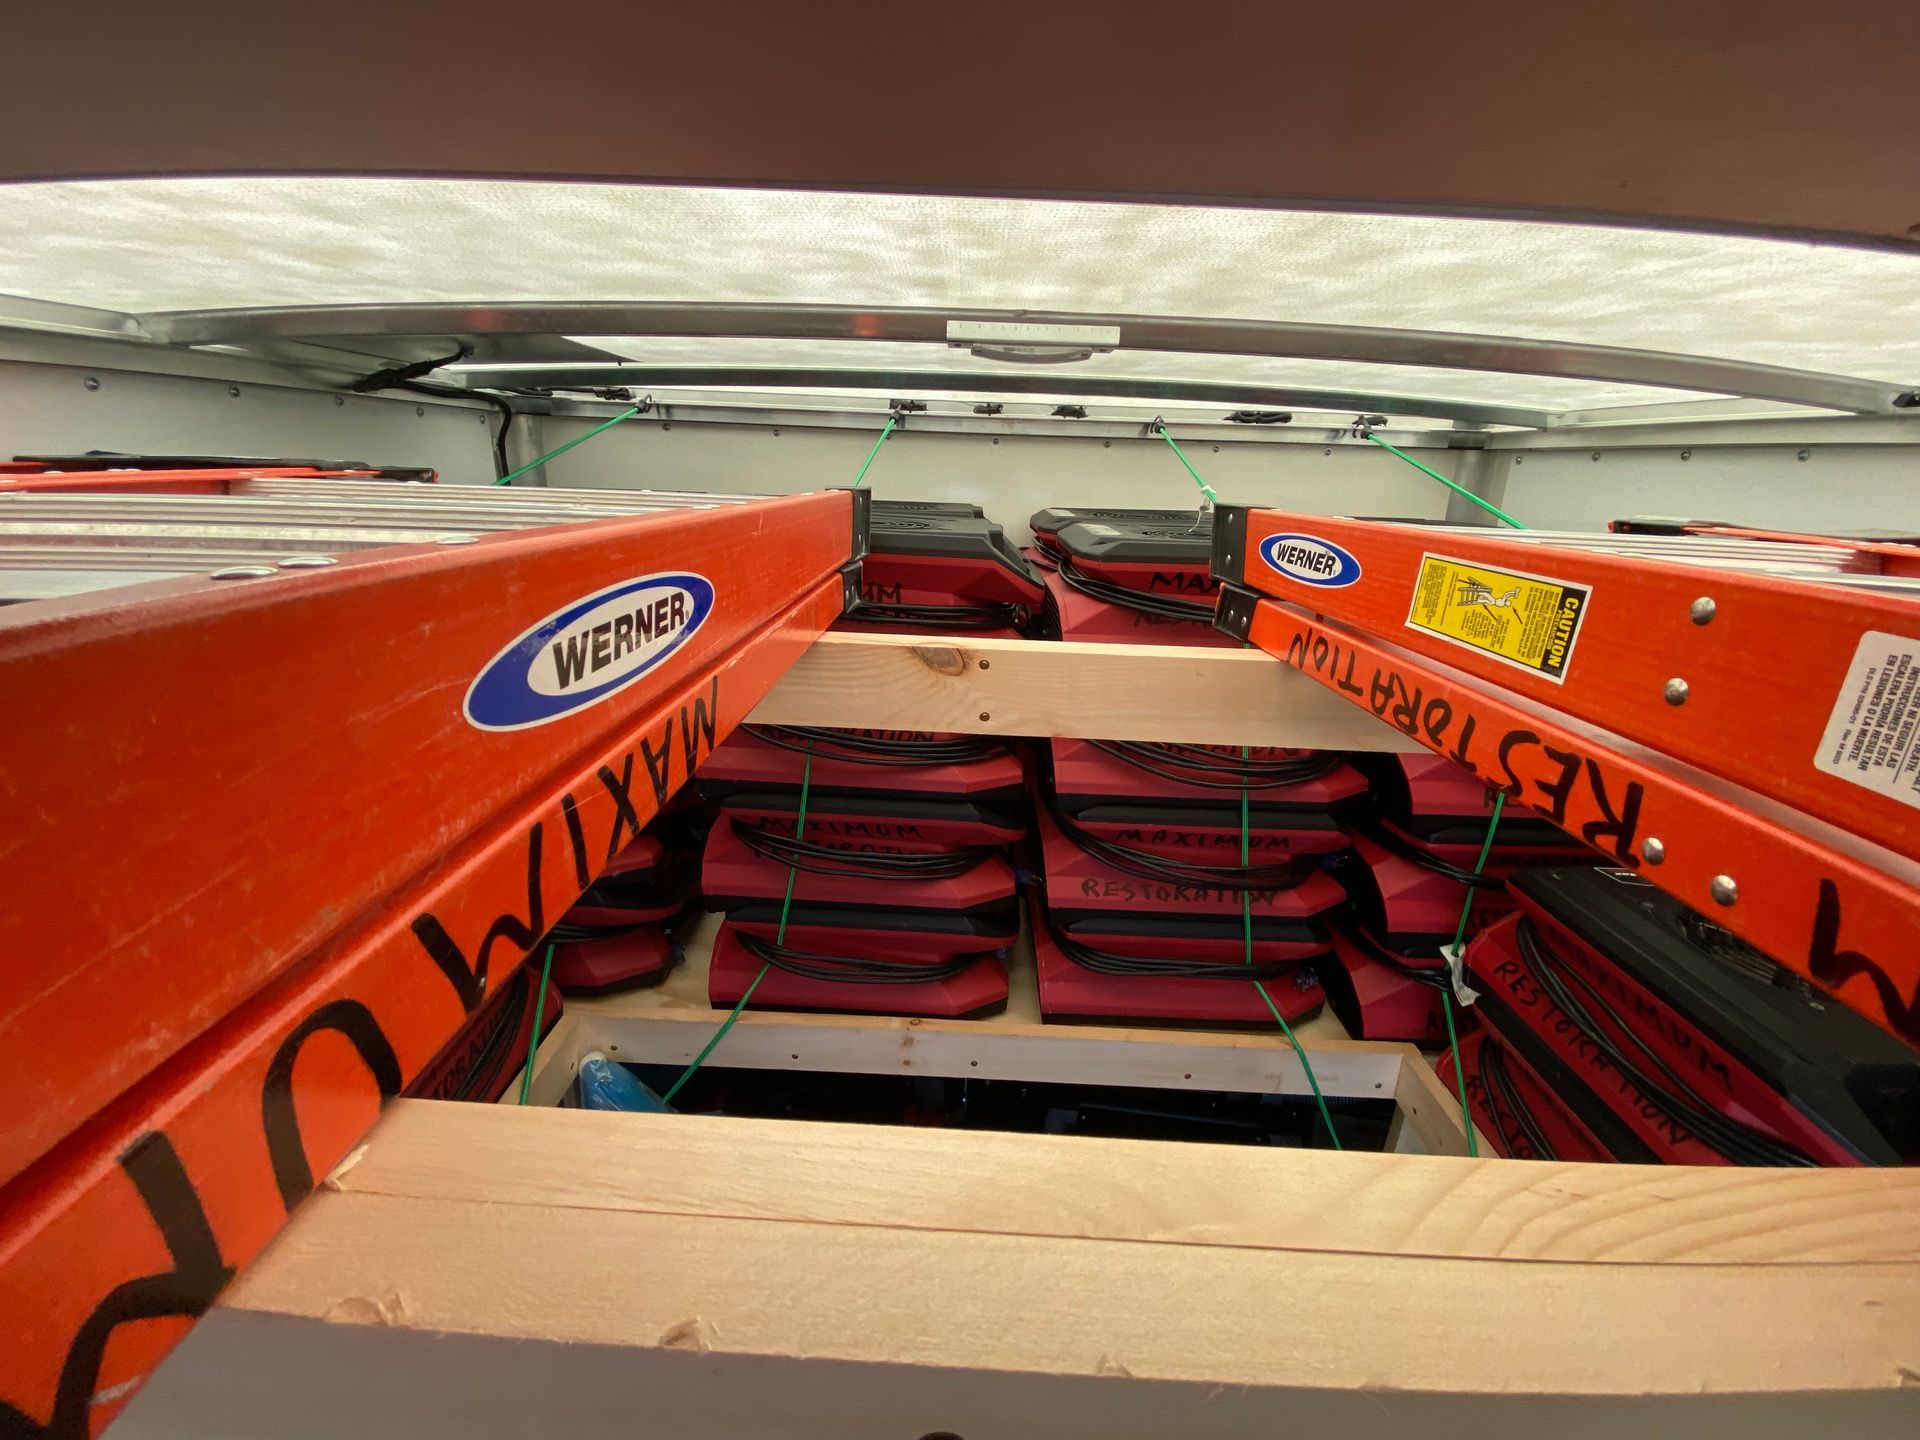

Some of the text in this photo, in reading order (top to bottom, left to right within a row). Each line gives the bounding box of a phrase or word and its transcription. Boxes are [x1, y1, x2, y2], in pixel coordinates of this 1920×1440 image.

[1276, 543, 1337, 576] WERNER
[552, 591, 689, 690] WERNER
[1546, 609, 1562, 650] PRECAUCIÓN
[1547, 596, 1579, 668] CAUTION
[1886, 655, 1898, 666] EN
[1871, 667, 1891, 708] LESIONES
[1857, 654, 1912, 771] ESCALERA PODRÍA RESULTAR
[1861, 716, 1873, 727] LA
[1873, 666, 1920, 766] INSTRUCCIONES DE ESTA
[1287, 627, 1644, 869] RESTORATION
[1848, 727, 1869, 761] MUERTE.
[1894, 719, 1914, 751] SEGUIR
[1886, 751, 1900, 768] LAS
